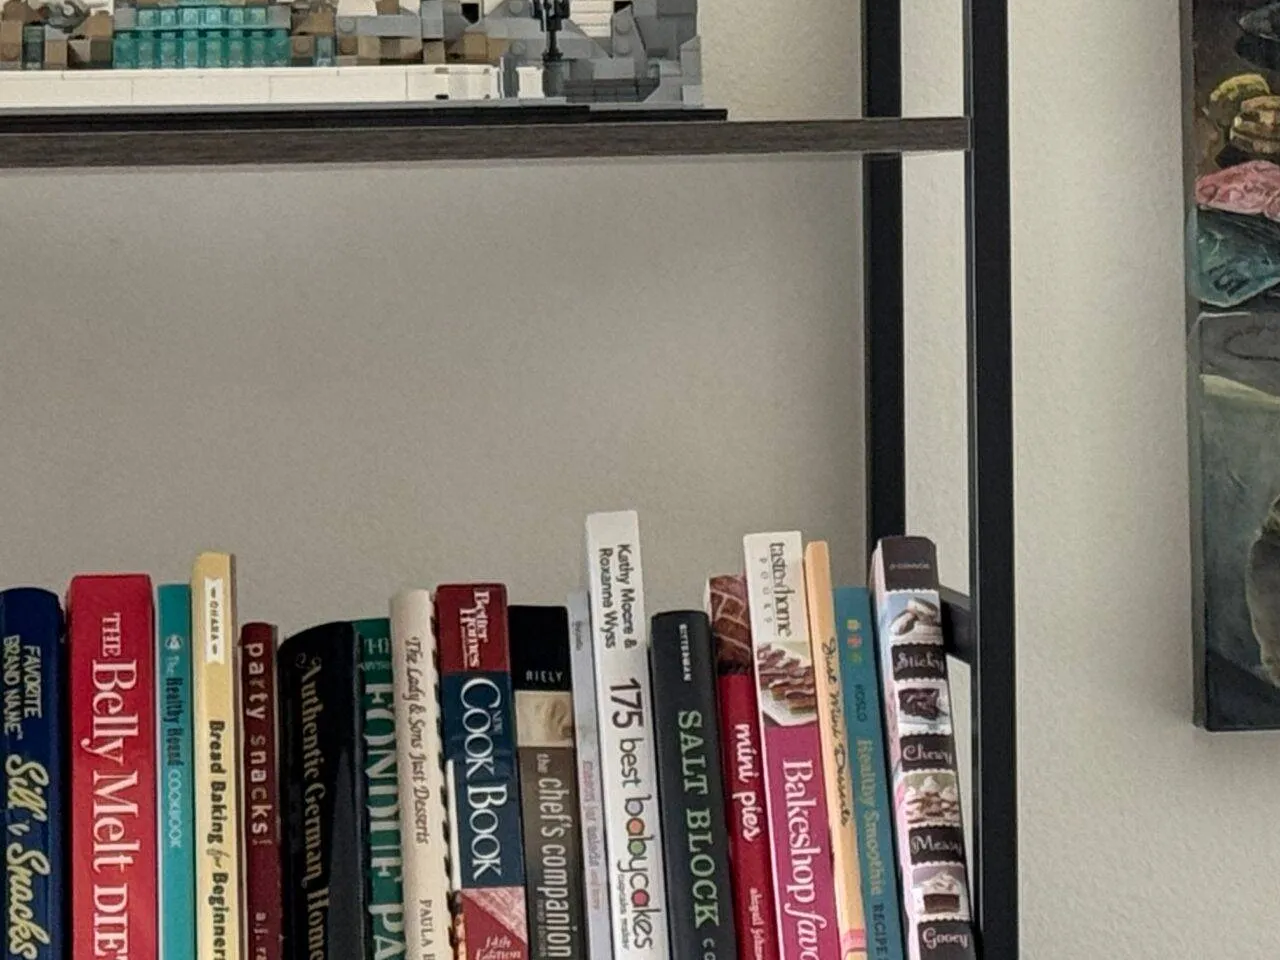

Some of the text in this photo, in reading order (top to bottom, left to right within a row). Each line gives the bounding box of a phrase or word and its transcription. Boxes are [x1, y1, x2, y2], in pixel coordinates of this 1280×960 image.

[459, 607, 481, 668] Homes
[473, 590, 490, 644] Better
[600, 610, 618, 649] Wyss
[617, 543, 637, 649] Kathy Moore &
[3, 633, 20, 686] BRAND
[22, 644, 43, 719] FAVORITE
[525, 669, 564, 684] RIELY
[894, 652, 945, 673] Sticky
[244, 642, 274, 846] party snacks!
[296, 652, 325, 780] Authentic
[402, 637, 431, 845] The Lady & Sons Just Desserts
[678, 709, 709, 795] SALT
[820, 636, 840, 683] Just
[834, 742, 852, 828] Desserts
[902, 743, 952, 765] Chewy
[80, 612, 141, 960] THE Belly Melt DIE
[301, 782, 326, 889] German
[609, 677, 662, 950] 175 best babycakes
[732, 723, 763, 843] mini pies
[782, 759, 822, 904] Bakeshop
[206, 720, 231, 960] Bread Baking for Beginner
[536, 753, 578, 958] the chef's companion
[685, 807, 720, 929] BLOCK
[855, 739, 889, 956] Healthy Smoothie RECIPE
[911, 834, 963, 856] Messy
[6, 841, 51, 960] Snacks
[418, 898, 435, 948] PAULA
[921, 925, 970, 951] Gooey
